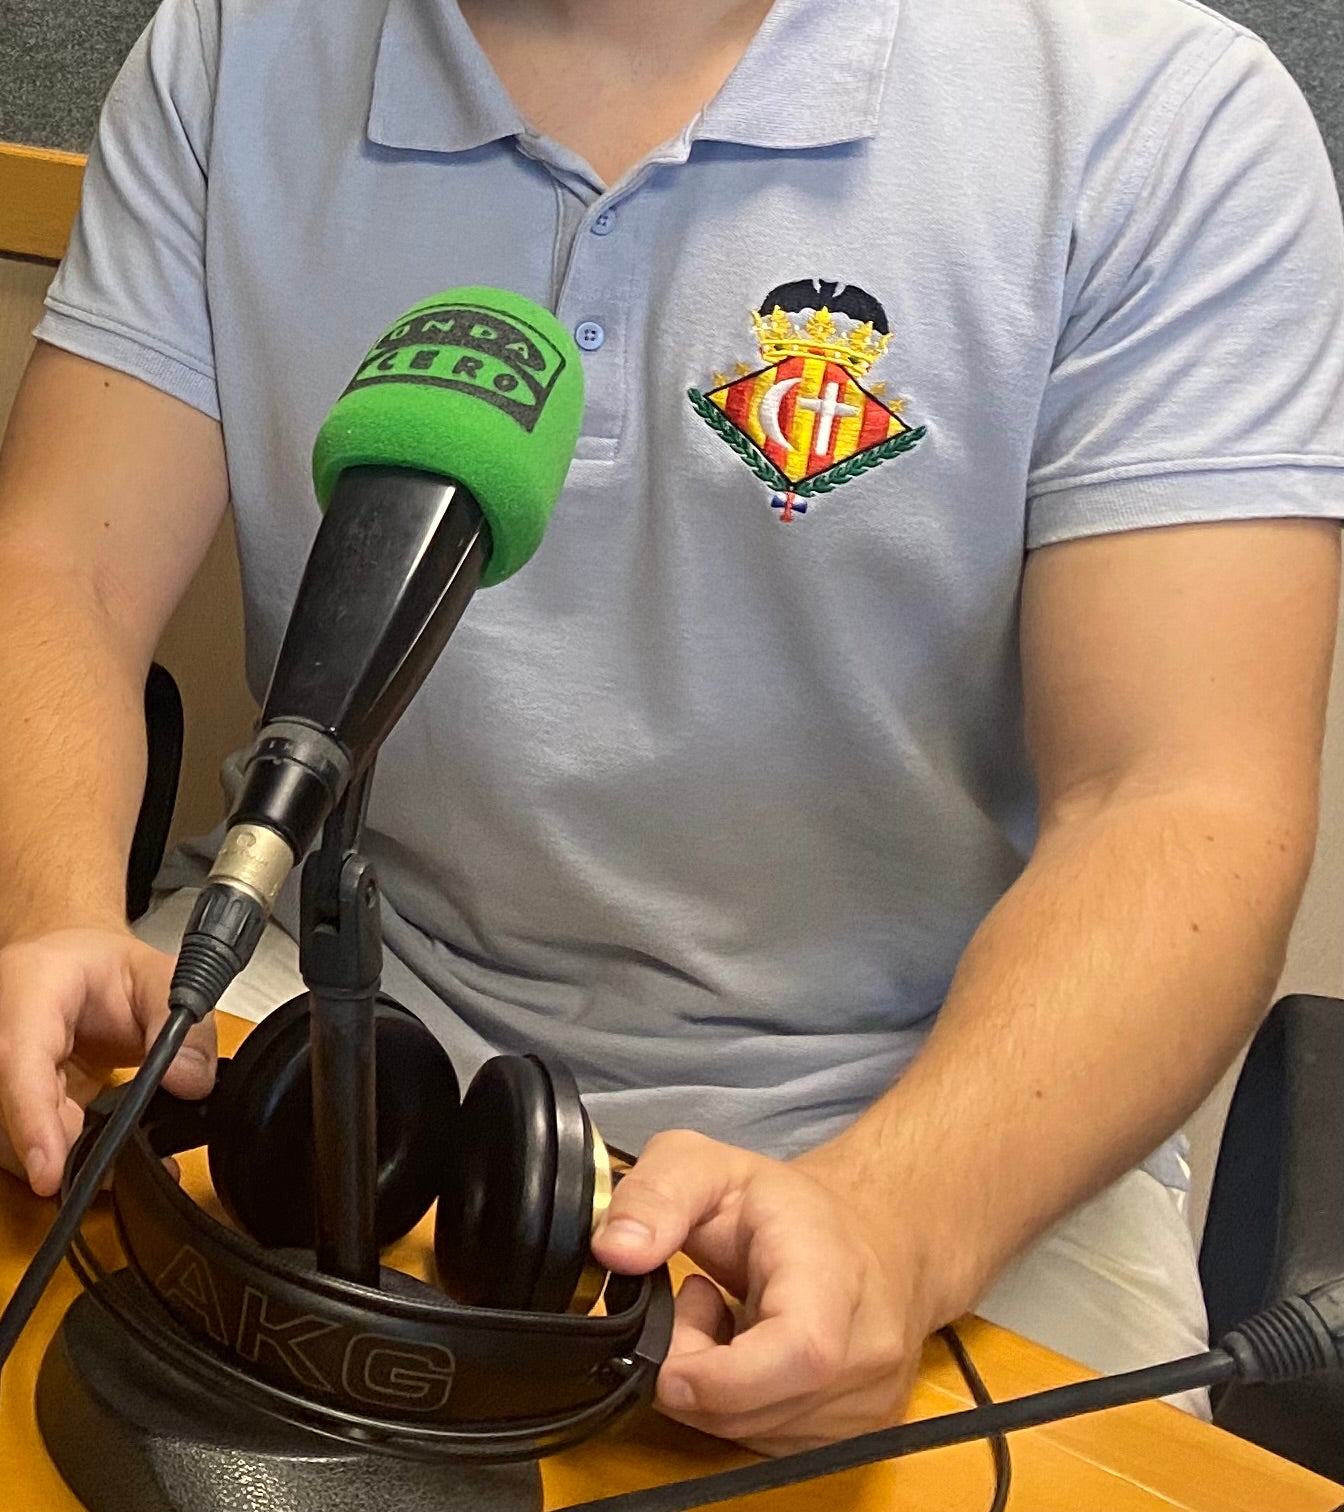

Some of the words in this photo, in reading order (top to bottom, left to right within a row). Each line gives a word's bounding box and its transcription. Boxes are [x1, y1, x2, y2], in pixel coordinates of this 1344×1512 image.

[389, 318, 530, 360] ONDA
[377, 349, 519, 393] CERO
[156, 1244, 456, 1413] AKG
